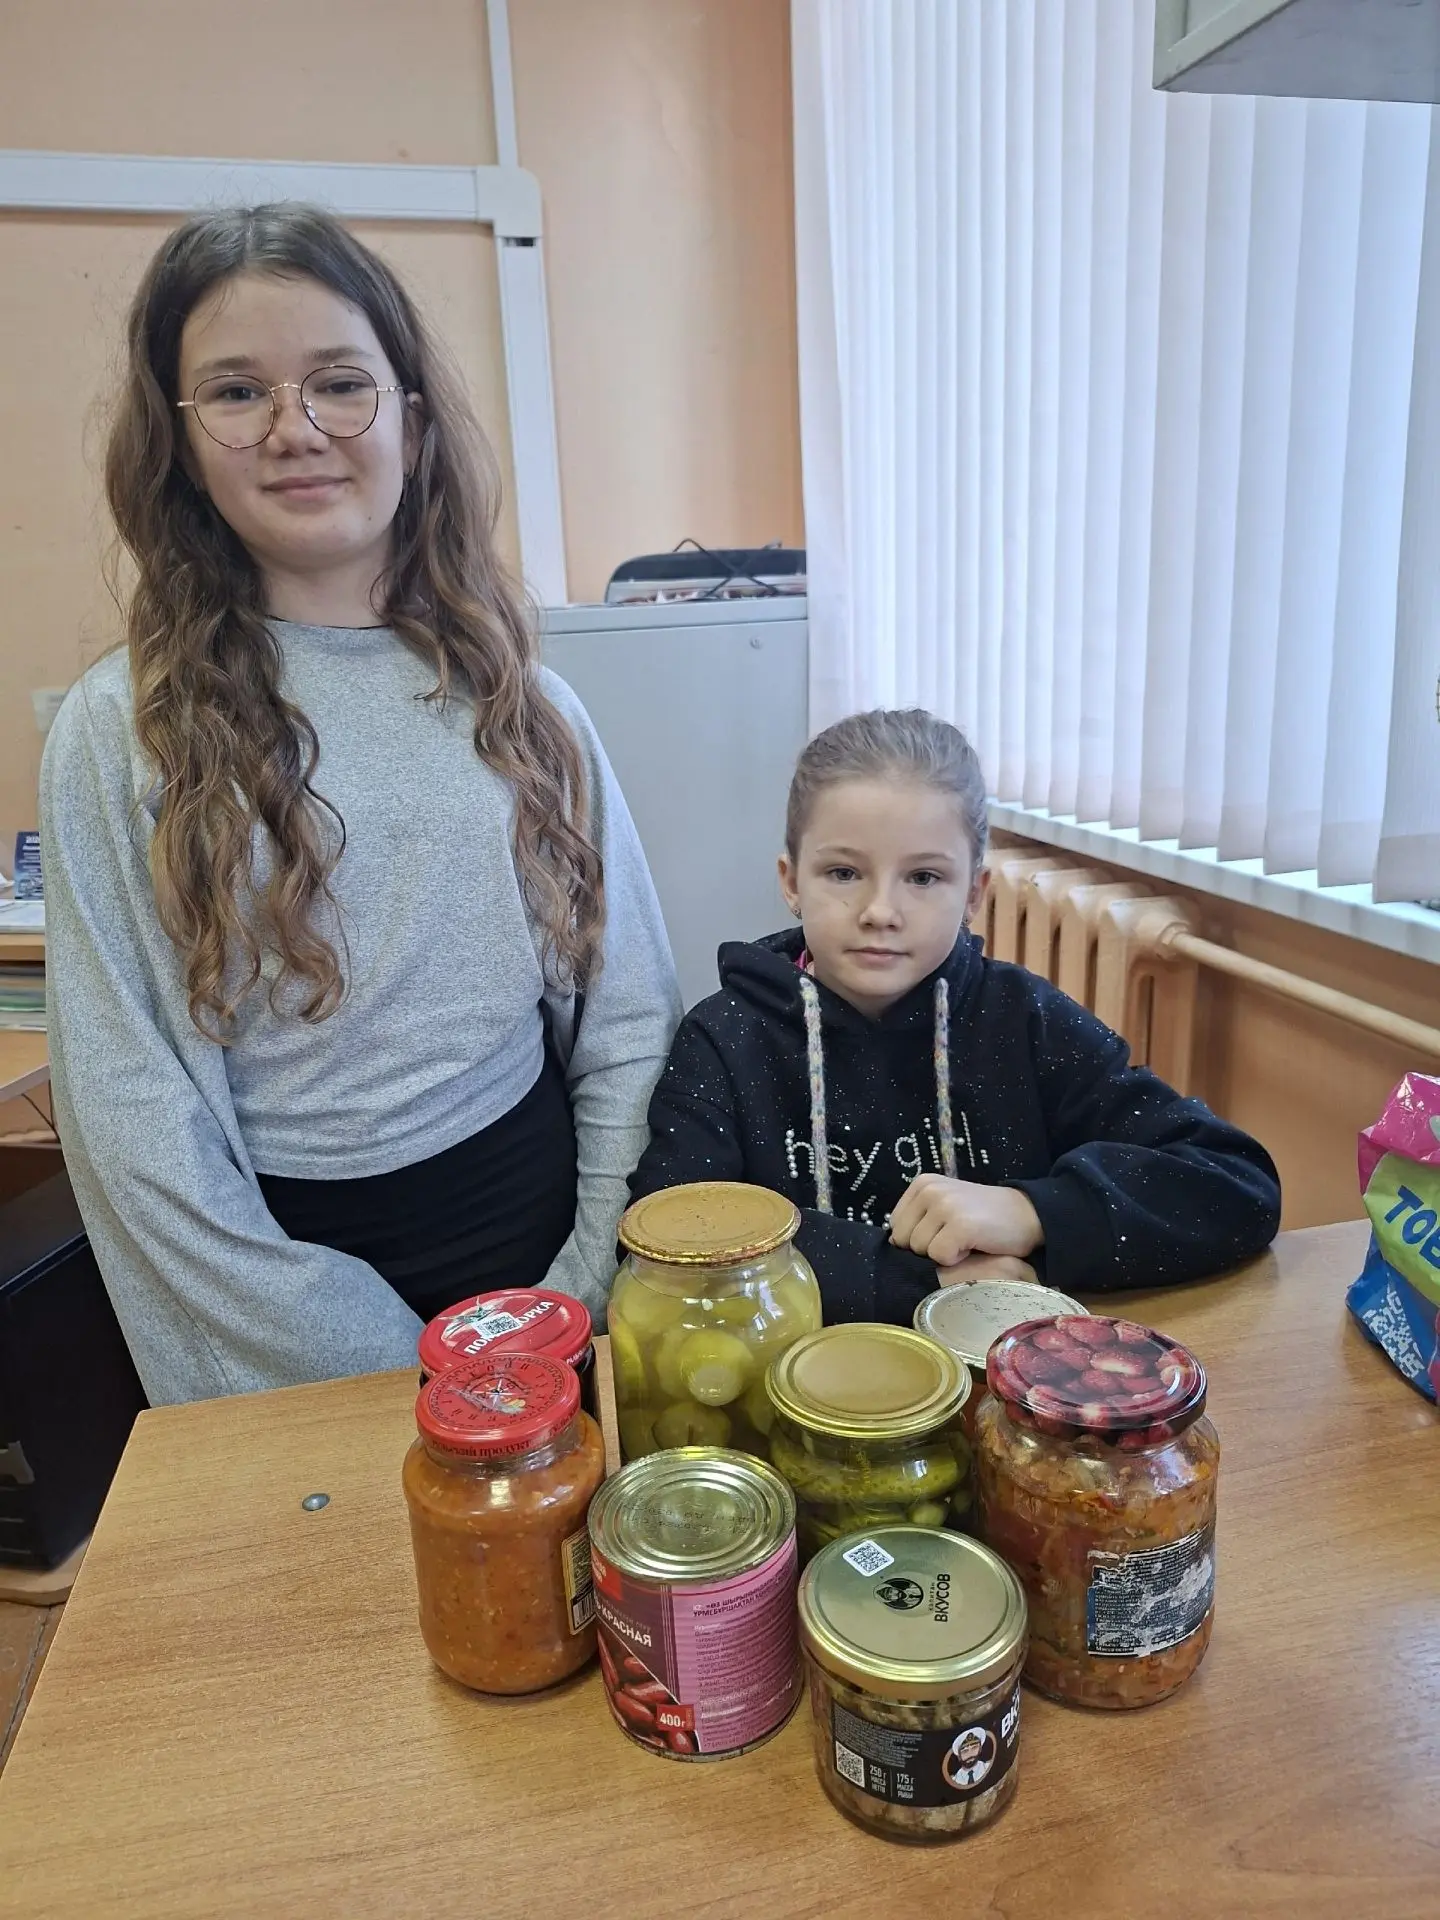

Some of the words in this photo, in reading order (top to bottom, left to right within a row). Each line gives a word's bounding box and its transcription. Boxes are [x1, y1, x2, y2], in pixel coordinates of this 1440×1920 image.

[785, 1129, 883, 1192] hey
[463, 1300, 555, 1355] ПООРКА
[934, 1573, 951, 1622] ВКУСОВ
[660, 1713, 681, 1728] 400
[869, 1764, 882, 1777] 250
[896, 1773, 910, 1784] 175
